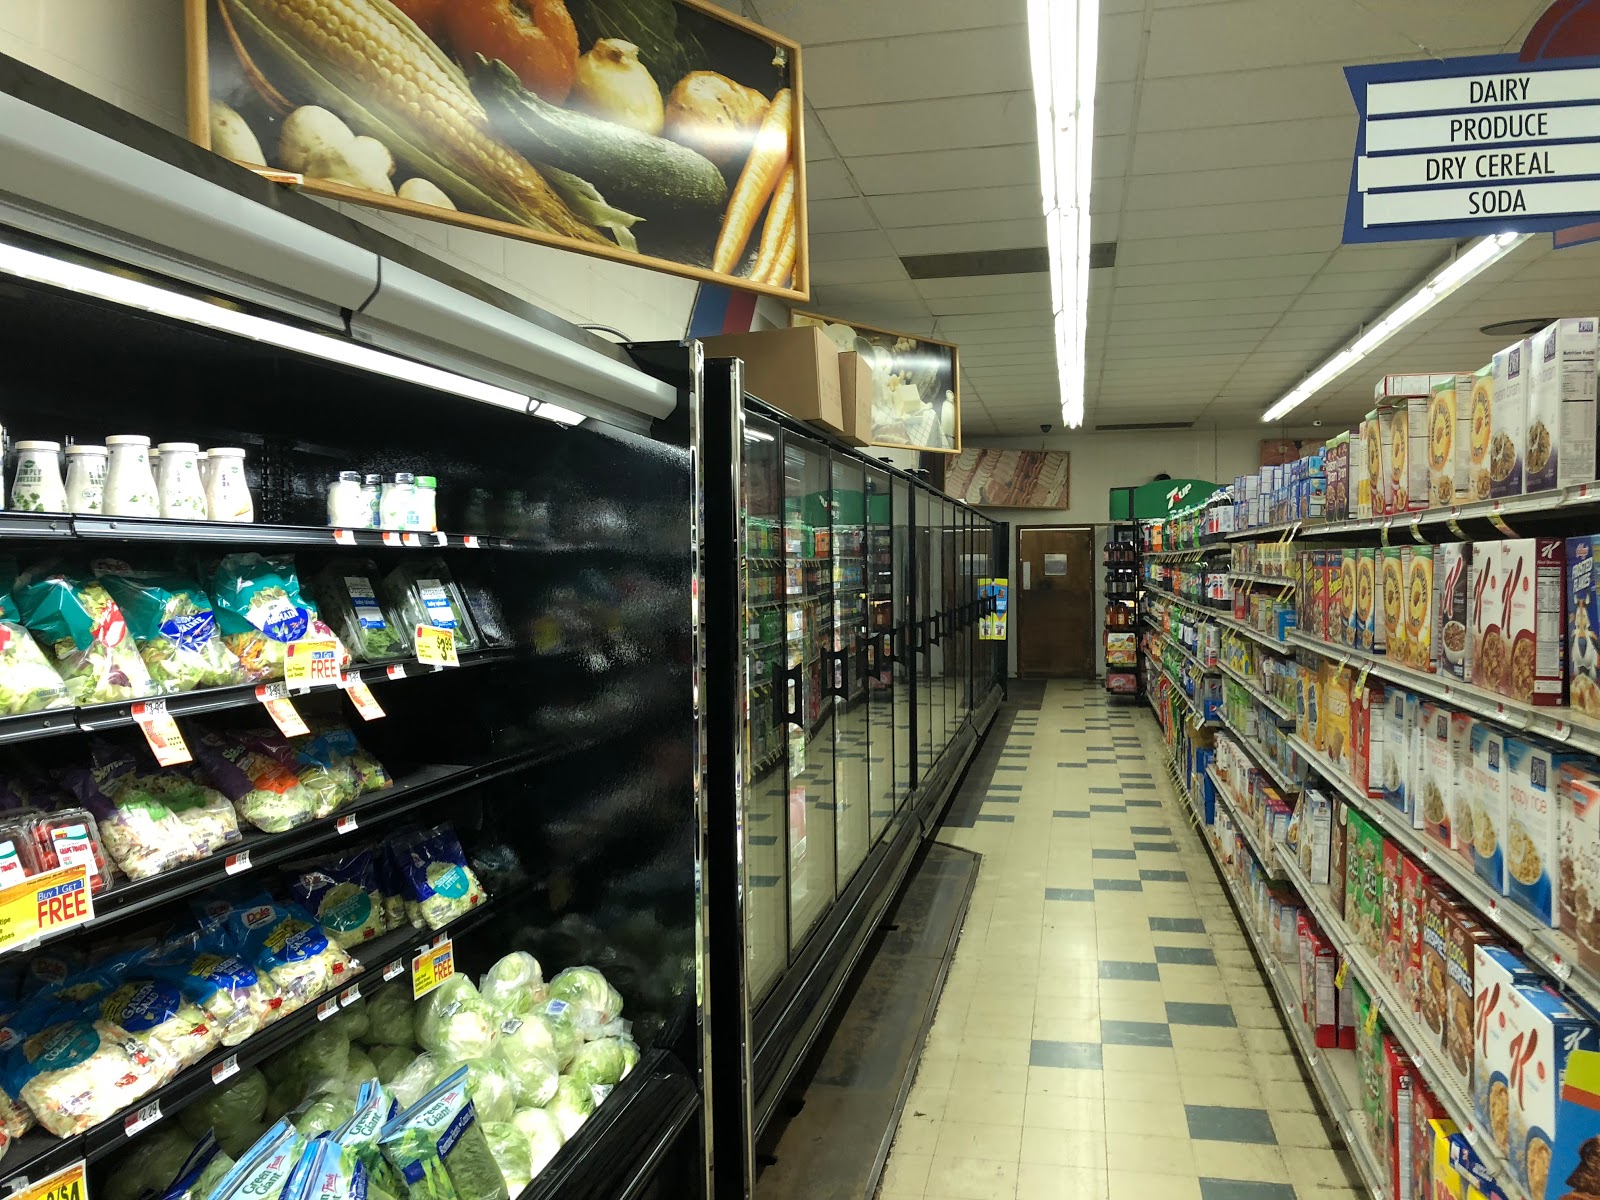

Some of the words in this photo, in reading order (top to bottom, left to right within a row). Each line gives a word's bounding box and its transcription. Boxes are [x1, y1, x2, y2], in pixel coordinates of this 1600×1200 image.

[1469, 77, 1531, 104] DAIRY
[1449, 113, 1548, 142] PRODUCE
[1426, 156, 1467, 182] DRY
[1475, 151, 1556, 179] CEREAL
[1468, 189, 1527, 215] SODA
[1501, 555, 1523, 640] K
[311, 658, 337, 679] FREE
[37, 888, 87, 929] FREE
[246, 907, 270, 924] Dole
[1426, 910, 1444, 938] COCOA
[434, 957, 453, 983] FREE
[1449, 940, 1468, 974] COCOA
[121, 982, 155, 1020] GARDEN
[1476, 982, 1500, 1059] K
[1509, 1028, 1538, 1112] K
[349, 1109, 374, 1136] Green
[360, 1112, 384, 1137] Giant
[425, 1104, 452, 1127] Giant
[267, 1154, 286, 1171] Fresh
[242, 1169, 272, 1195] Green
[255, 1171, 284, 1196] Giant
